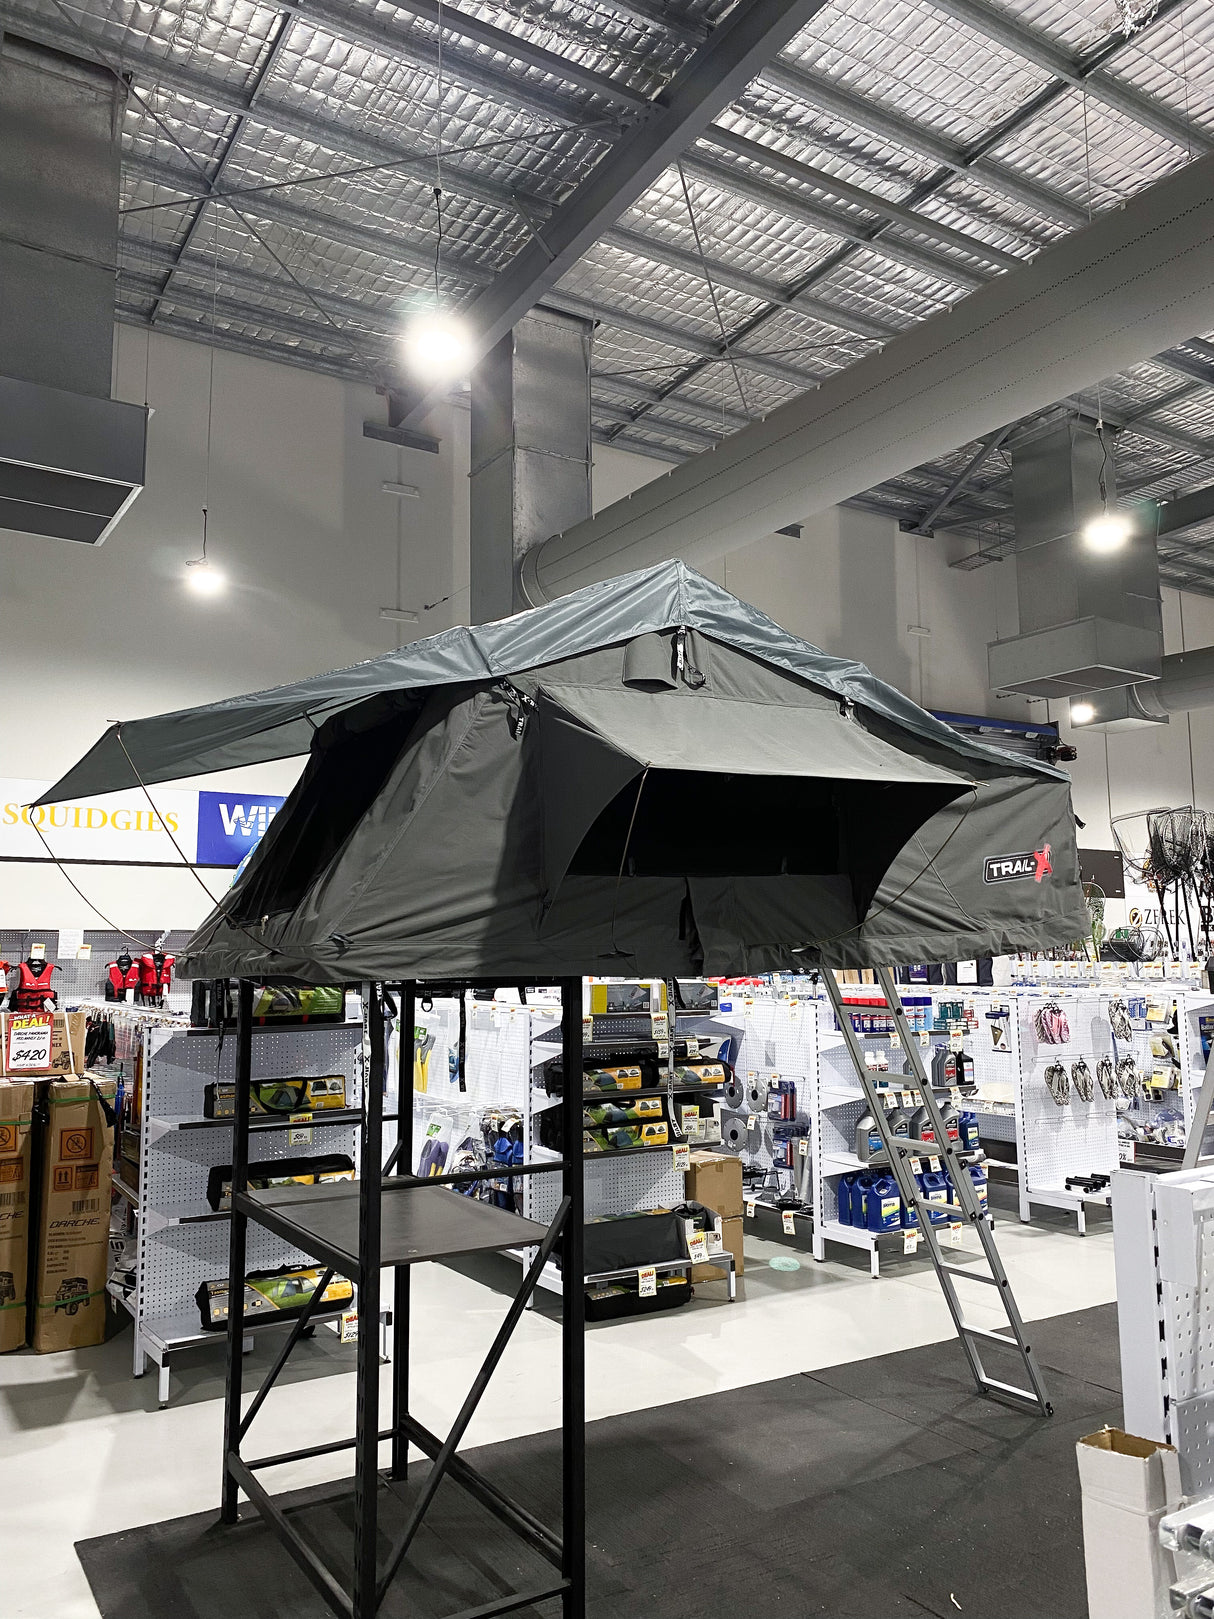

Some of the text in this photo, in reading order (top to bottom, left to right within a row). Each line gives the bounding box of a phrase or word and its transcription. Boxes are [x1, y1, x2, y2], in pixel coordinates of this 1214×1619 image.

[2, 802, 179, 833] SQUIDGIES
[989, 843, 1053, 883] TRAIL-X
[12, 1015, 50, 1030] DEAL!
[12, 1048, 47, 1061] $420
[49, 1218, 100, 1228] DARCHE
